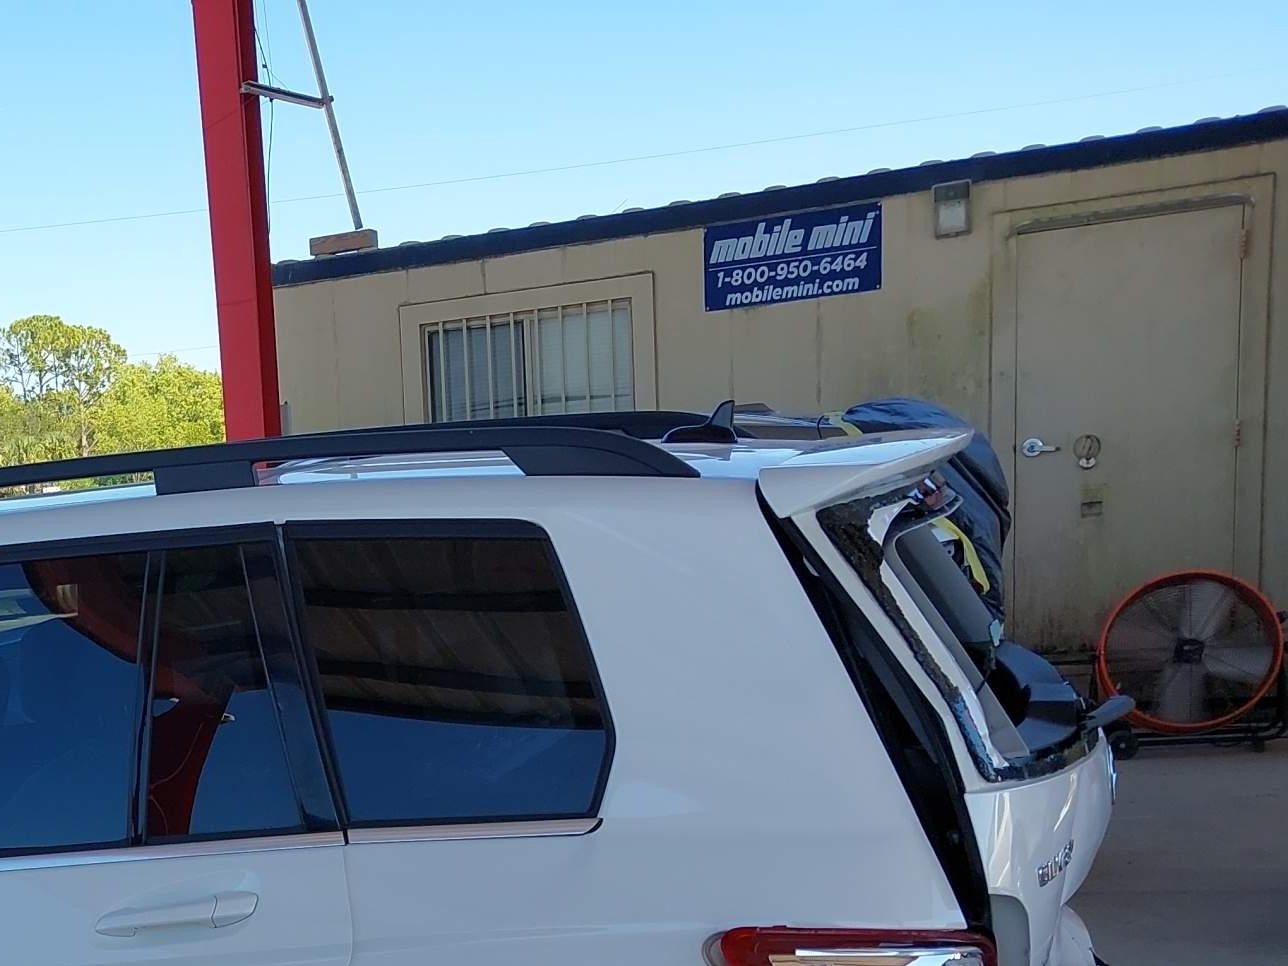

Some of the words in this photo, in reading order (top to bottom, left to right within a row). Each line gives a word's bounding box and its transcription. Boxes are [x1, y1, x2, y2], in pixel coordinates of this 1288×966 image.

[709, 218, 805, 264] mobile
[807, 211, 875, 251] mini
[717, 252, 868, 288] 1-800-950-6464
[725, 276, 859, 306] mobilemini.com
